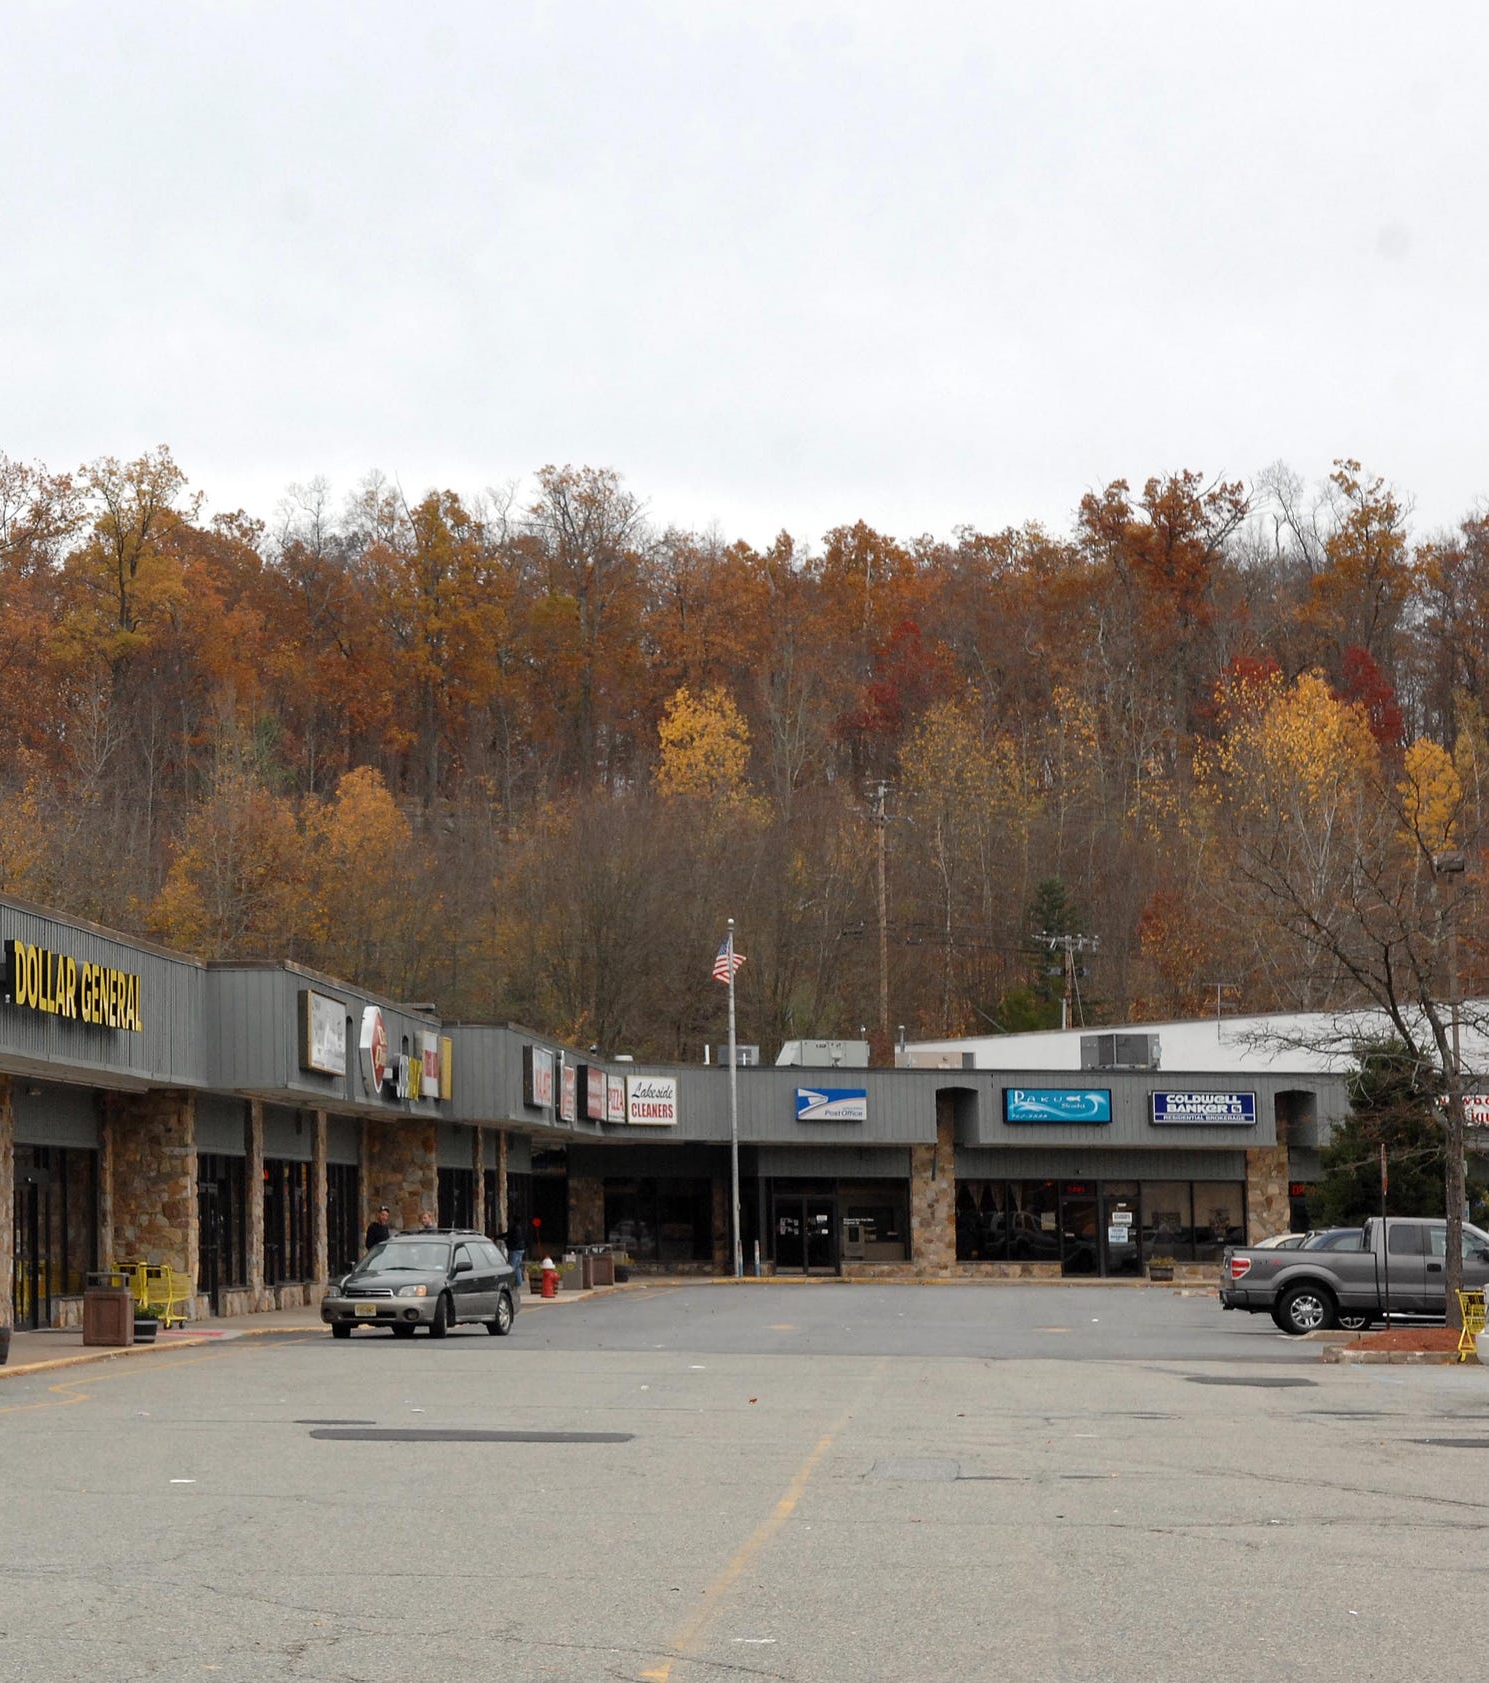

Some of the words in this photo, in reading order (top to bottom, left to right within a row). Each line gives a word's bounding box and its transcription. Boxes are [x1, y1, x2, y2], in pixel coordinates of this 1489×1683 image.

[14, 939, 77, 1019] DOLLAR
[81, 960, 142, 1032] GENERAL
[631, 1081, 673, 1099] Lakeside
[631, 1102, 674, 1119] CLEANERS
